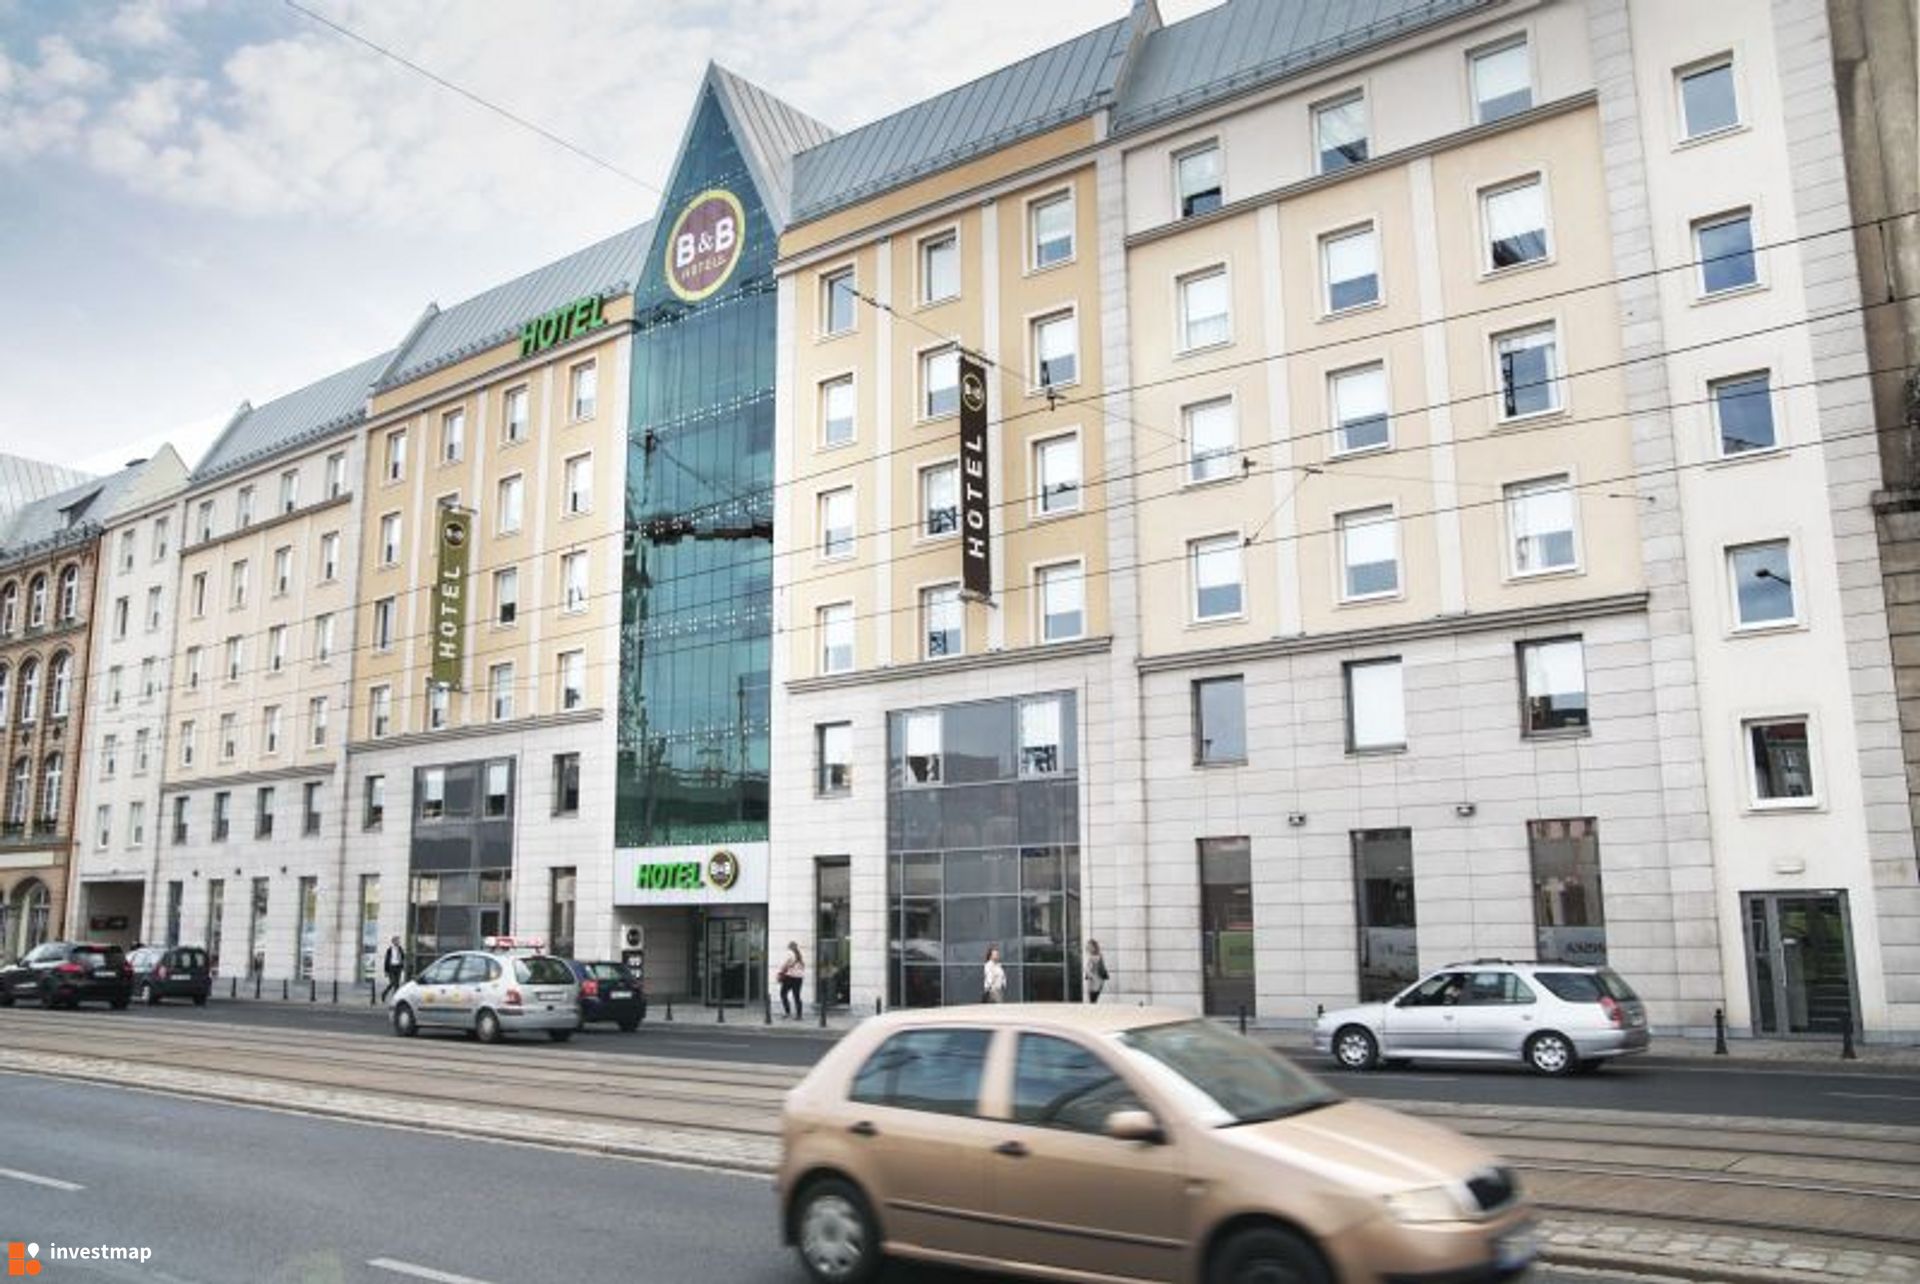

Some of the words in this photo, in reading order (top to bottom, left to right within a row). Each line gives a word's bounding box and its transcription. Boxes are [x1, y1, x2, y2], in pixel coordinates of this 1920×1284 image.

[676, 216, 735, 268] B&B
[519, 294, 608, 356] HOTEL
[965, 434, 985, 558] HOTEL
[439, 566, 461, 658] HOTEL
[637, 862, 706, 889] HOTEL
